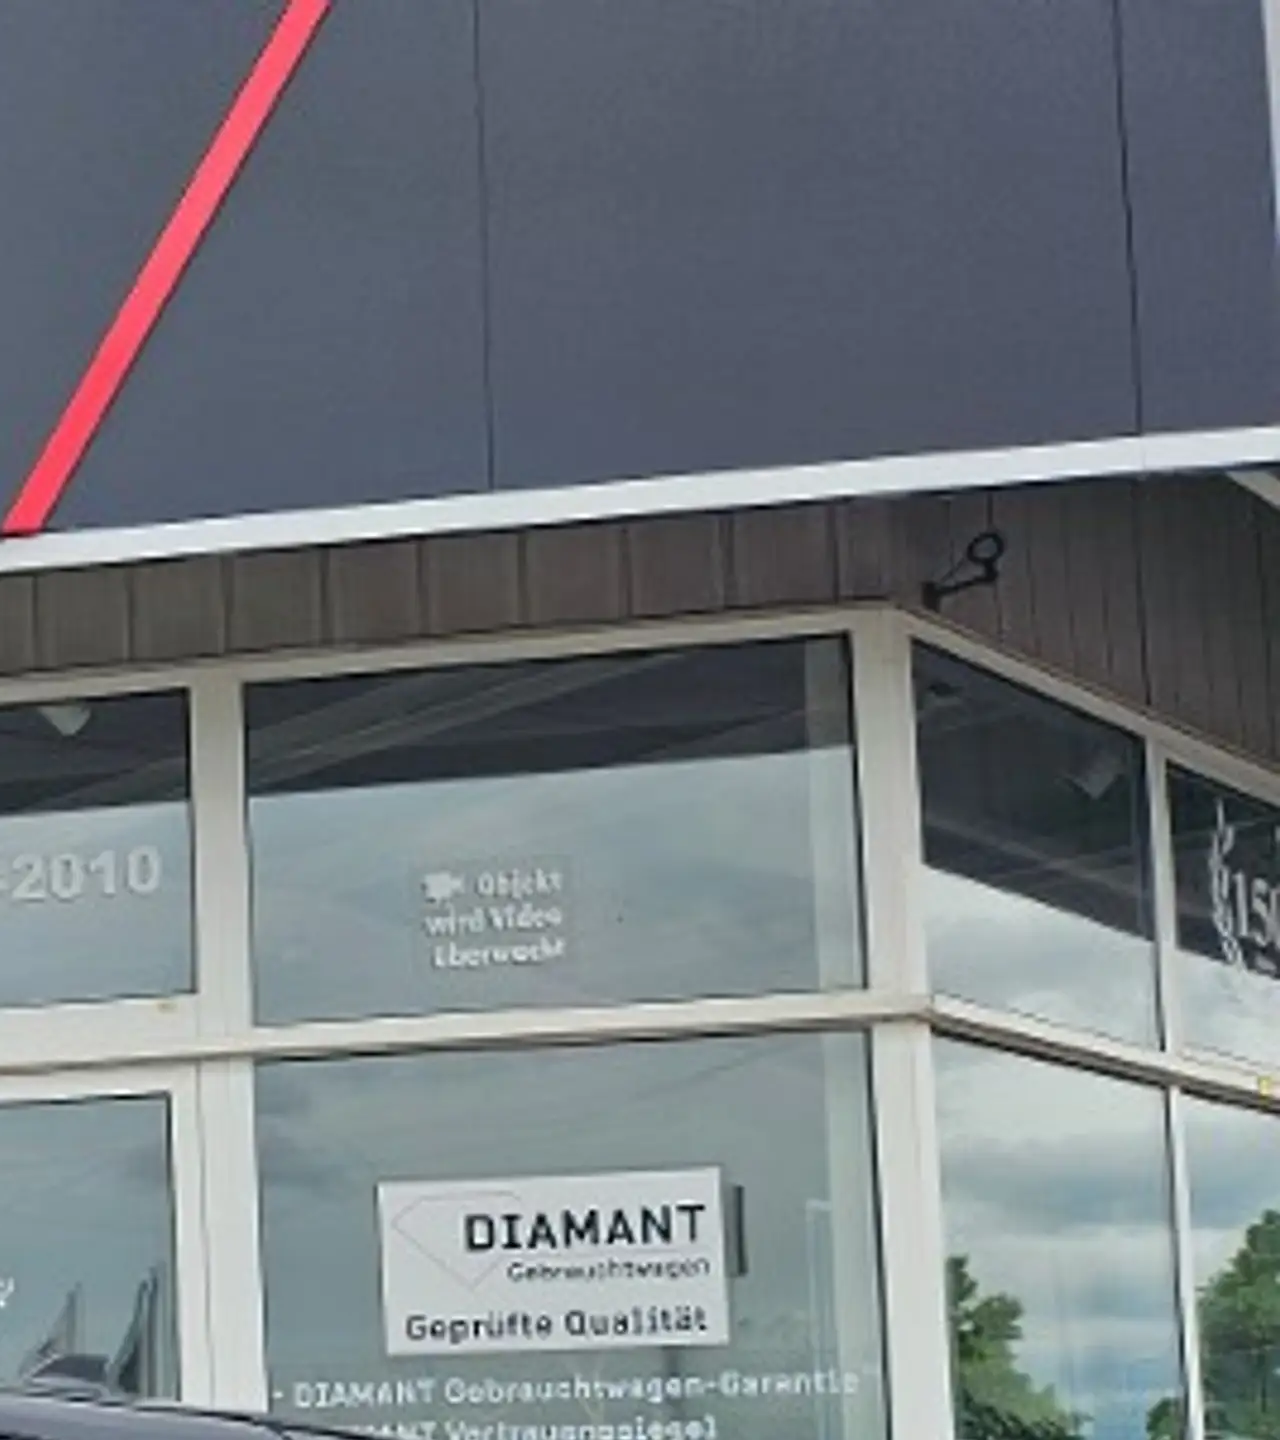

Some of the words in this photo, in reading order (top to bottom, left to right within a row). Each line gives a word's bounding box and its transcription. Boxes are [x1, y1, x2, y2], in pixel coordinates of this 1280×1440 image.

[463, 1203, 707, 1251] DIAMANT
[506, 1257, 711, 1283] Gebrauchtwagen
[404, 1310, 553, 1344] Geprüfte
[563, 1304, 708, 1337] Qualität
[294, 1376, 437, 1409] DIAMANT
